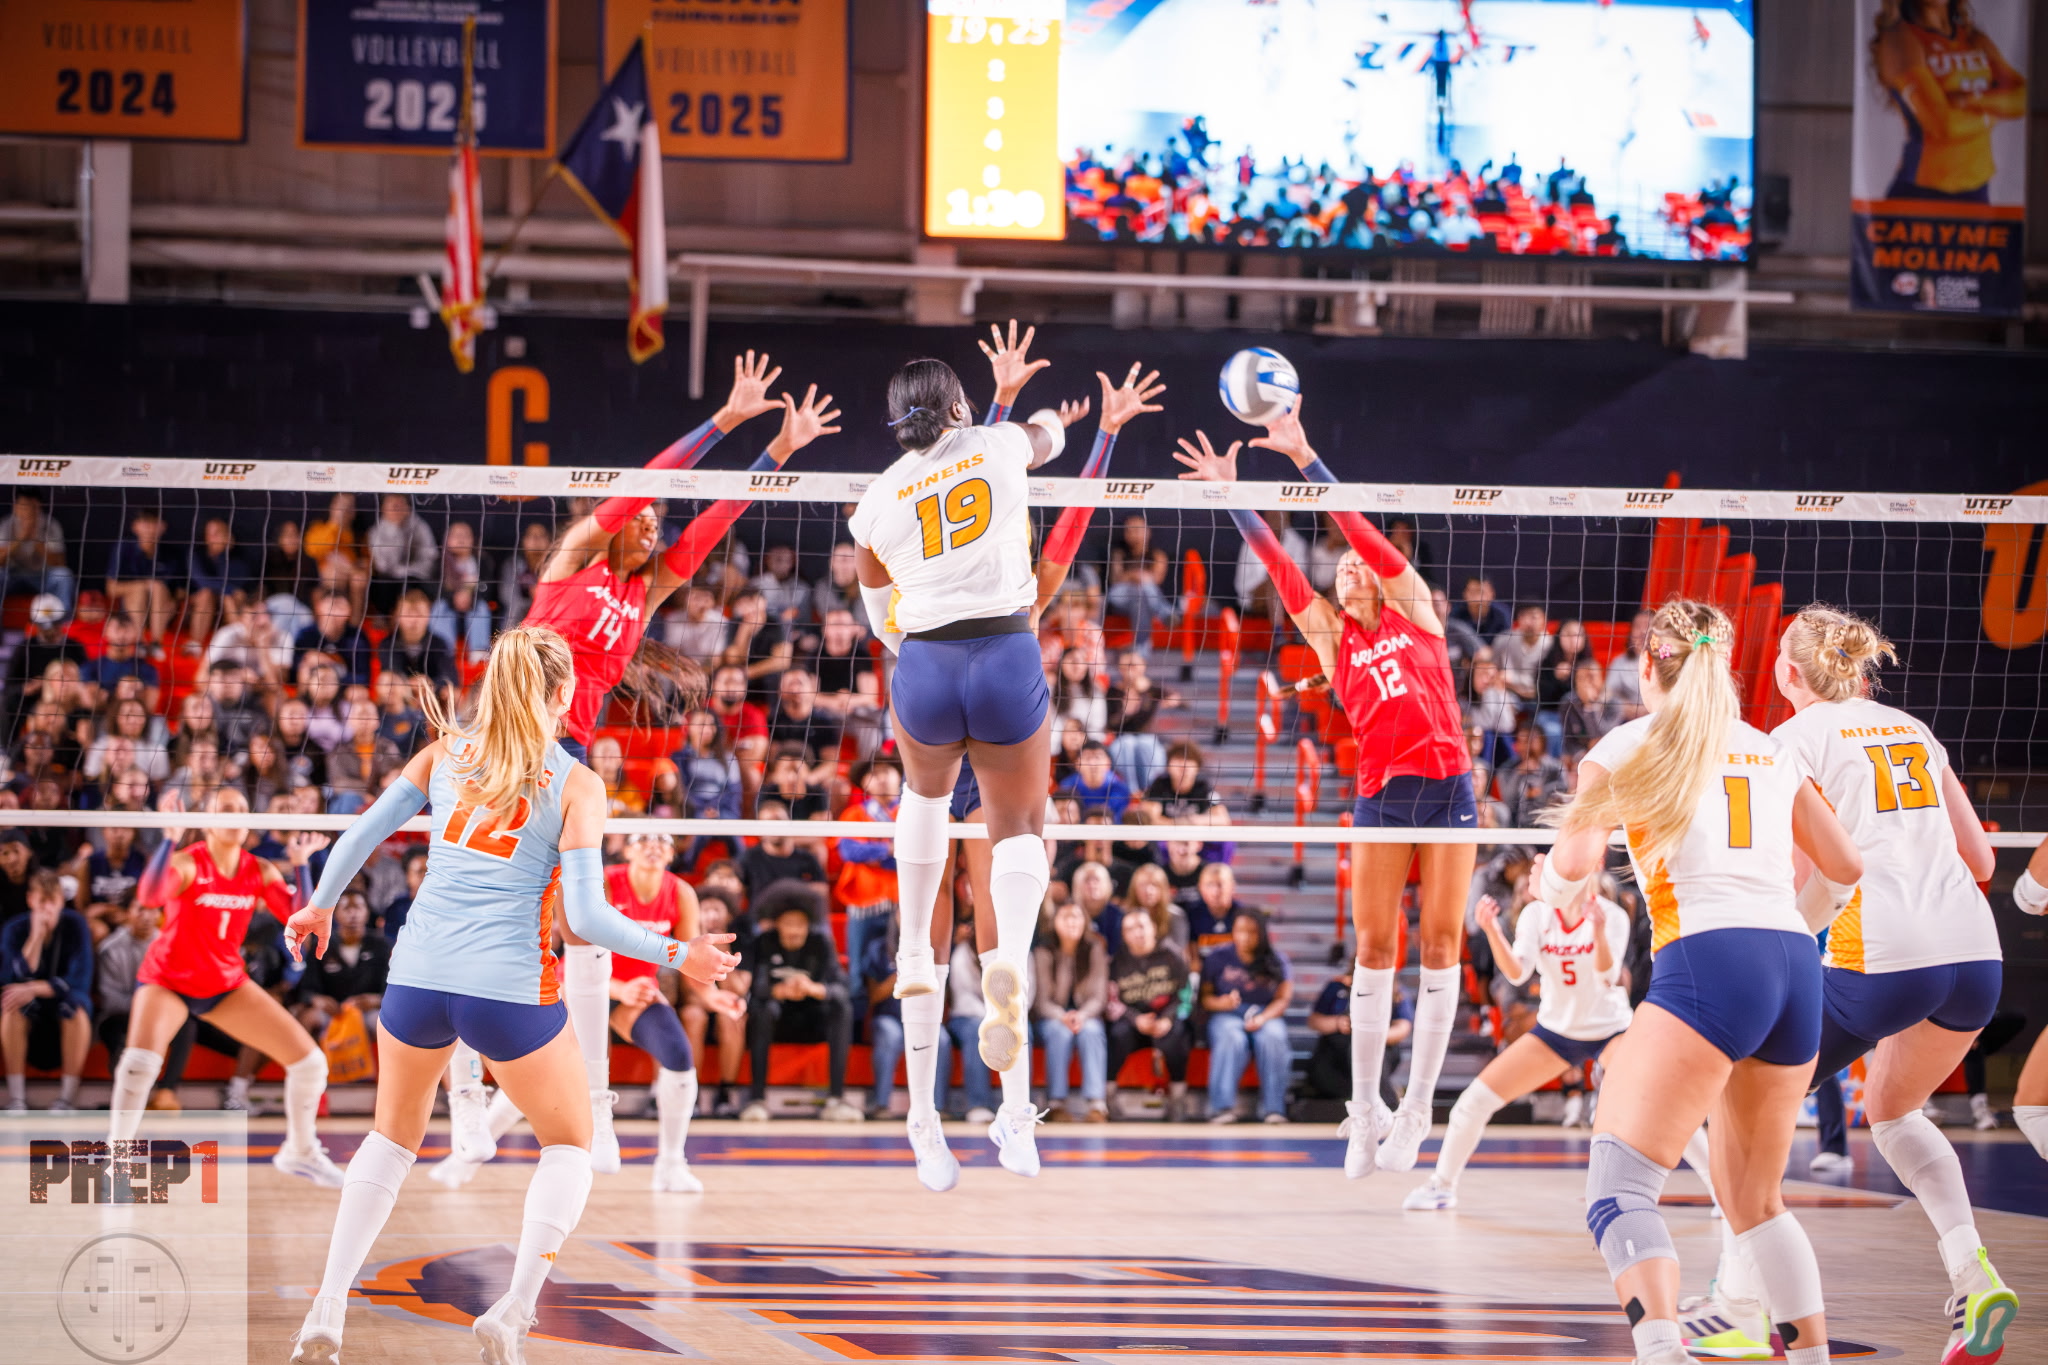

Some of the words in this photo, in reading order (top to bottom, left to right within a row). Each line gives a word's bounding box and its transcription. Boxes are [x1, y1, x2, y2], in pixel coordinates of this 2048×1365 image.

[43, 23, 192, 54] VOLLEYBALL
[352, 33, 500, 69] VOLLEYBLL
[57, 69, 176, 116] 2024
[669, 92, 782, 138] 2025
[1866, 220, 2009, 248] CARYME
[1872, 247, 2001, 273] MOLINA
[19, 460, 71, 471] UTEP
[205, 463, 257, 475] UTEP
[389, 467, 440, 479] UTEP
[570, 471, 621, 482] UTEP
[897, 453, 984, 500] MINERS
[751, 475, 800, 487] UTEP
[1106, 482, 1155, 494] UTEP
[1281, 486, 1330, 497] UTEP
[1454, 489, 1503, 500] UTEP
[1626, 492, 1674, 503] UTEP
[1796, 495, 1844, 507] UTEP
[1965, 498, 2013, 510] UTEP
[915, 478, 992, 560] 19
[588, 607, 623, 651] 14
[1350, 633, 1413, 667] ARIZONA
[1369, 658, 1408, 701] 12
[1840, 725, 1918, 739] MINERS
[1727, 753, 1775, 766] ERS
[1863, 742, 1940, 813] 13
[440, 779, 533, 861] 12
[1723, 776, 1752, 849] 1
[195, 893, 256, 910] ARIZON
[218, 911, 231, 940] 1
[1561, 961, 1577, 986] 5
